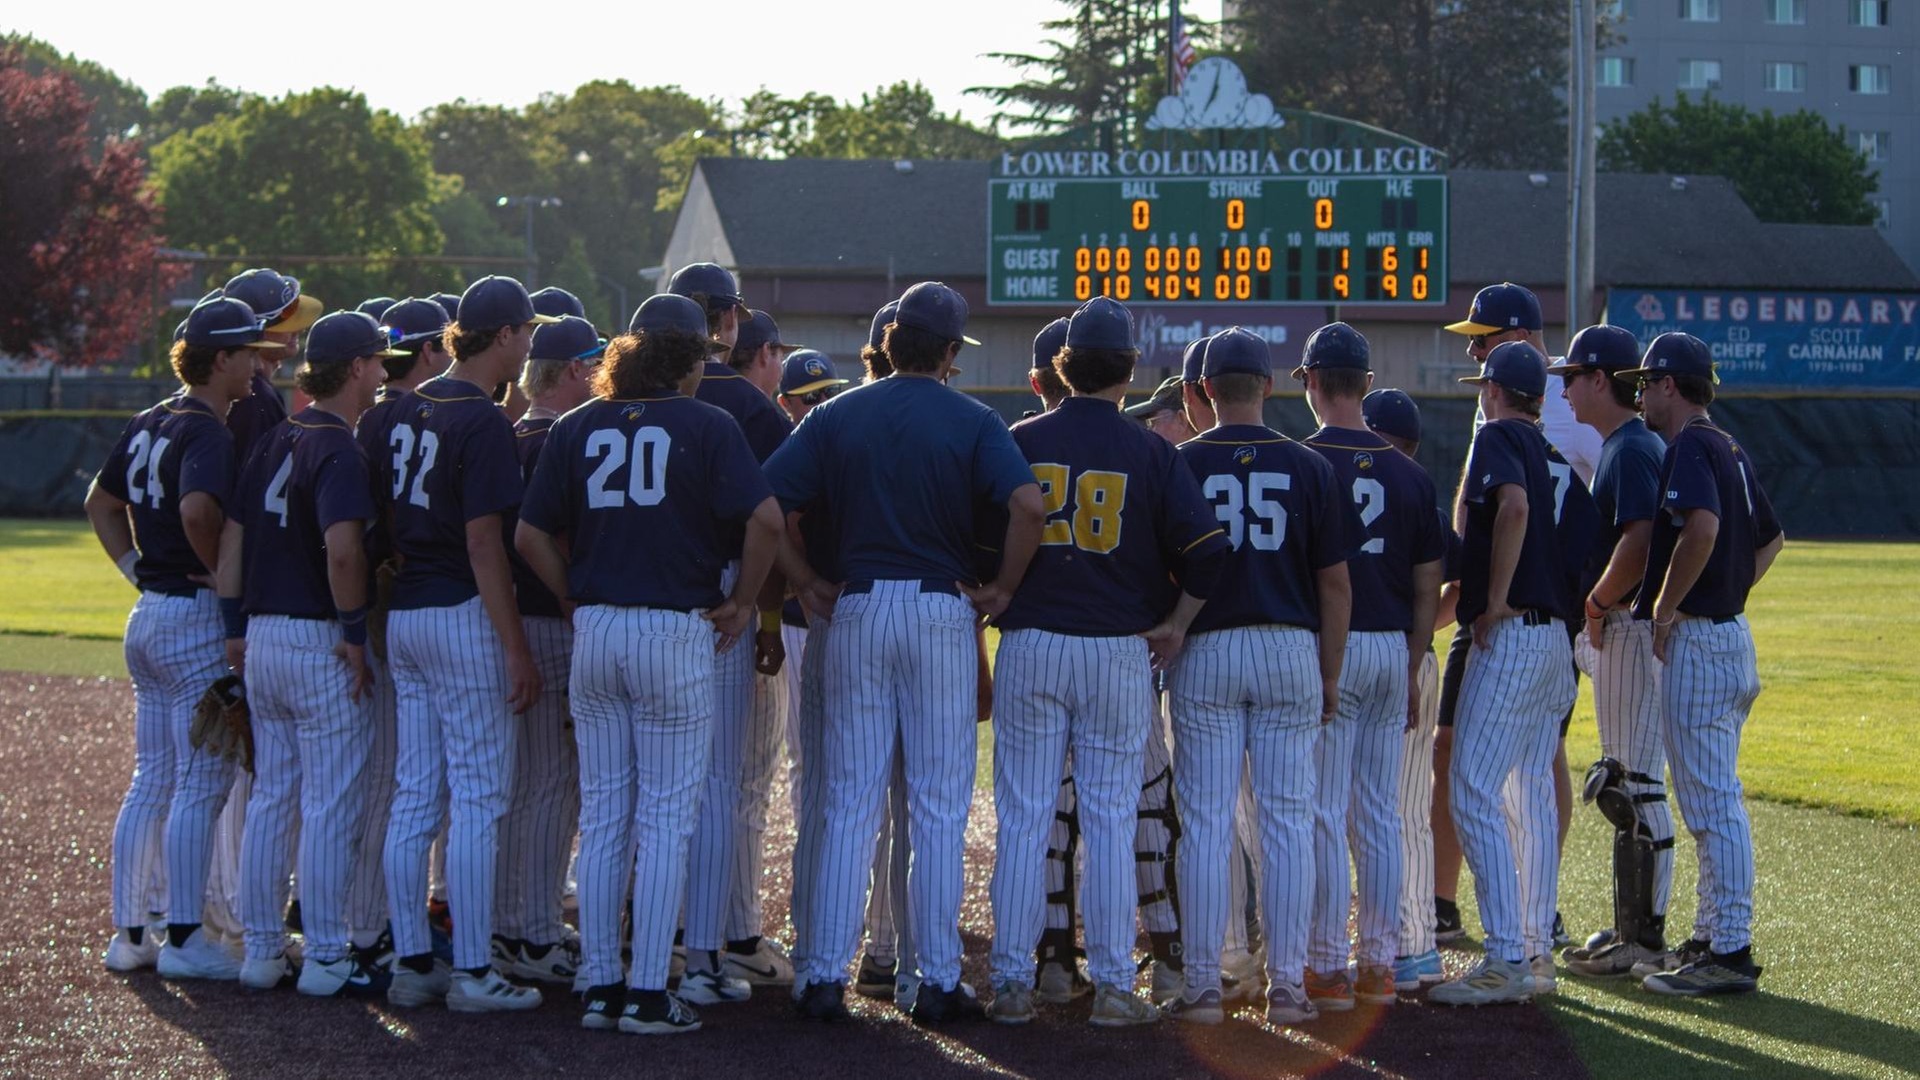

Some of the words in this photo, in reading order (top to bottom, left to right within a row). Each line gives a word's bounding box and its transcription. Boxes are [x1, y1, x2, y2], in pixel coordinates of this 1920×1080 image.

[1001, 151, 1111, 176] LOWER
[1117, 150, 1280, 175] COLUMBIA
[1288, 148, 1437, 173] COLLEGE
[1007, 183, 1026, 199] AT
[1029, 182, 1057, 199] BAT
[1121, 182, 1159, 198] BALL
[1208, 181, 1261, 197] STRIKE
[1307, 180, 1339, 197] OUT
[1386, 180, 1413, 197] H/E
[1132, 200, 1150, 231] 0
[1226, 199, 1245, 230] 0
[1315, 199, 1333, 229] 0
[1080, 234, 1087, 246] 1
[1099, 234, 1108, 246] 2
[1119, 233, 1128, 246] 3
[1149, 233, 1158, 246] 4
[1168, 233, 1178, 246] 5
[1189, 233, 1198, 246] 6
[1220, 233, 1228, 246] 7
[1258, 233, 1267, 246] 9
[1287, 233, 1300, 246] 10
[1315, 232, 1350, 247] RUNS
[1367, 232, 1396, 246] HITS
[1408, 232, 1433, 246] ERR
[1004, 249, 1060, 270] GUEST
[1382, 246, 1398, 272] 6
[1005, 277, 1058, 298] HOME
[1412, 274, 1428, 300] 0
[1676, 296, 1917, 323] LEGENDARY
[1160, 320, 1203, 343] red
[1727, 326, 1750, 342] ED
[1810, 328, 1863, 344] SCOTT
[1711, 343, 1767, 358] CHEFF
[1788, 344, 1883, 360] CARNAHAN
[126, 430, 171, 509] 24
[389, 423, 439, 510] 32
[585, 426, 672, 509] 20
[265, 451, 293, 528] 4
[1029, 462, 1128, 554] 28
[1203, 472, 1291, 552] 35
